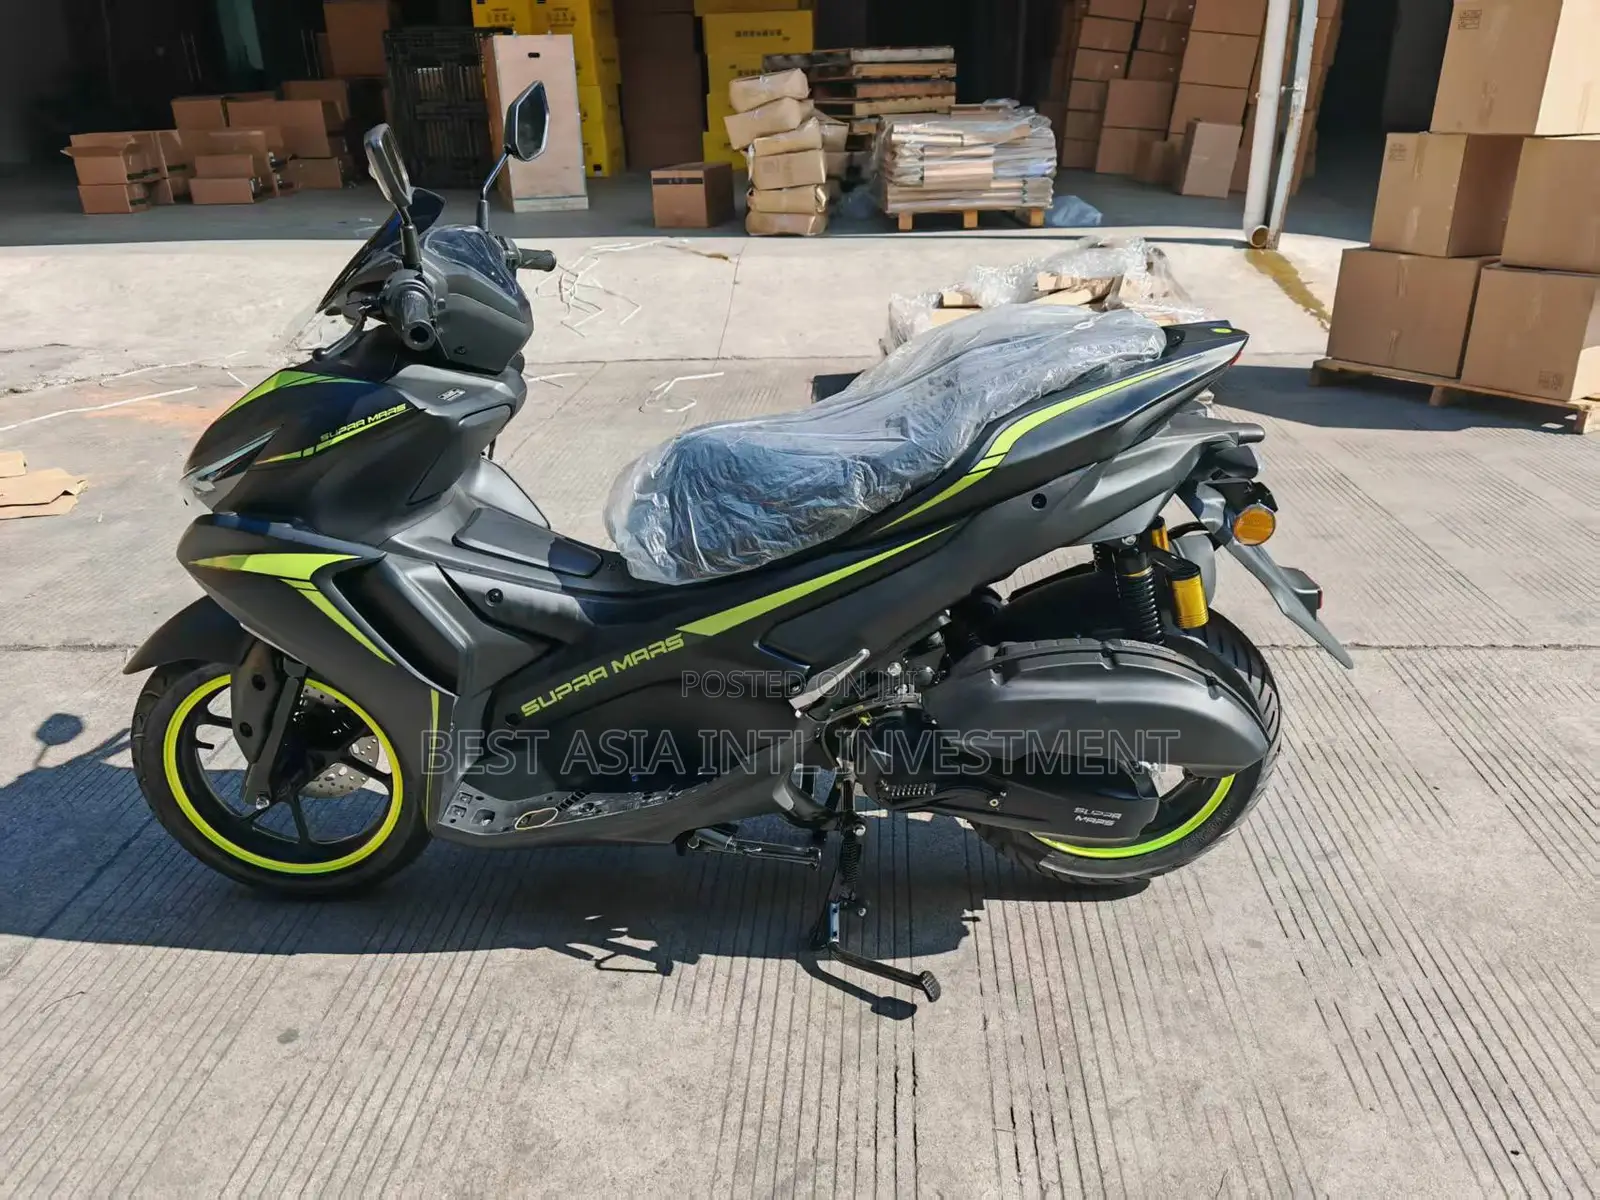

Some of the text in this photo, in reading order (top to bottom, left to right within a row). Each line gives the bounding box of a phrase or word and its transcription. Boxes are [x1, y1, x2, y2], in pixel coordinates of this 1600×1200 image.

[320, 403, 407, 442] SUPRA MARS
[520, 632, 684, 717] SUPRA MARS
